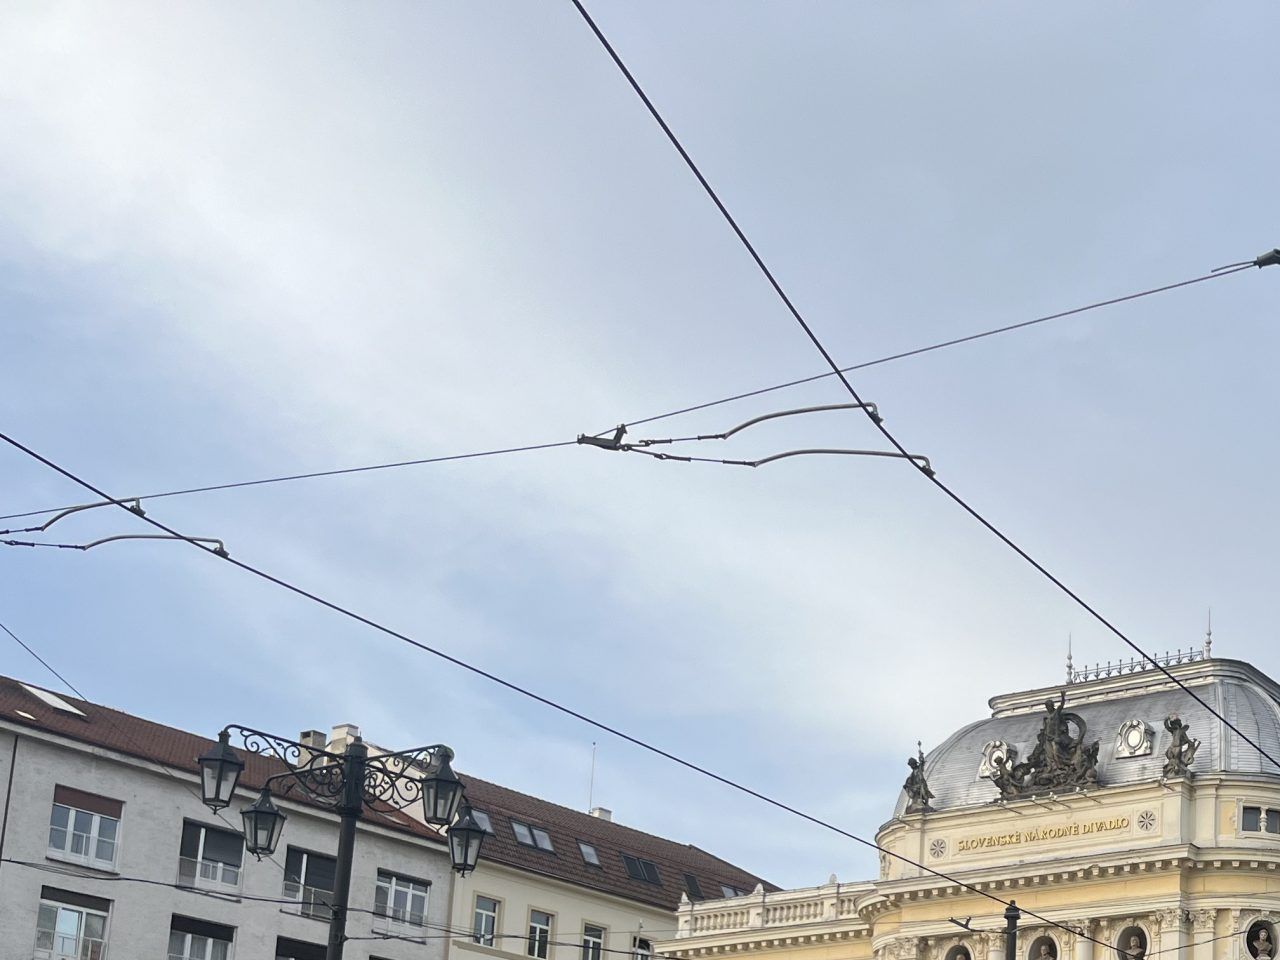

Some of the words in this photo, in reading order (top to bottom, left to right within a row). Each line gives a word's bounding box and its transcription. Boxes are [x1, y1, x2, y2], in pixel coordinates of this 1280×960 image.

[958, 831, 1021, 851] SLOVENSKÉ
[1023, 822, 1080, 842] NÁRODNÉ
[1081, 818, 1130, 834] DIVADLO
